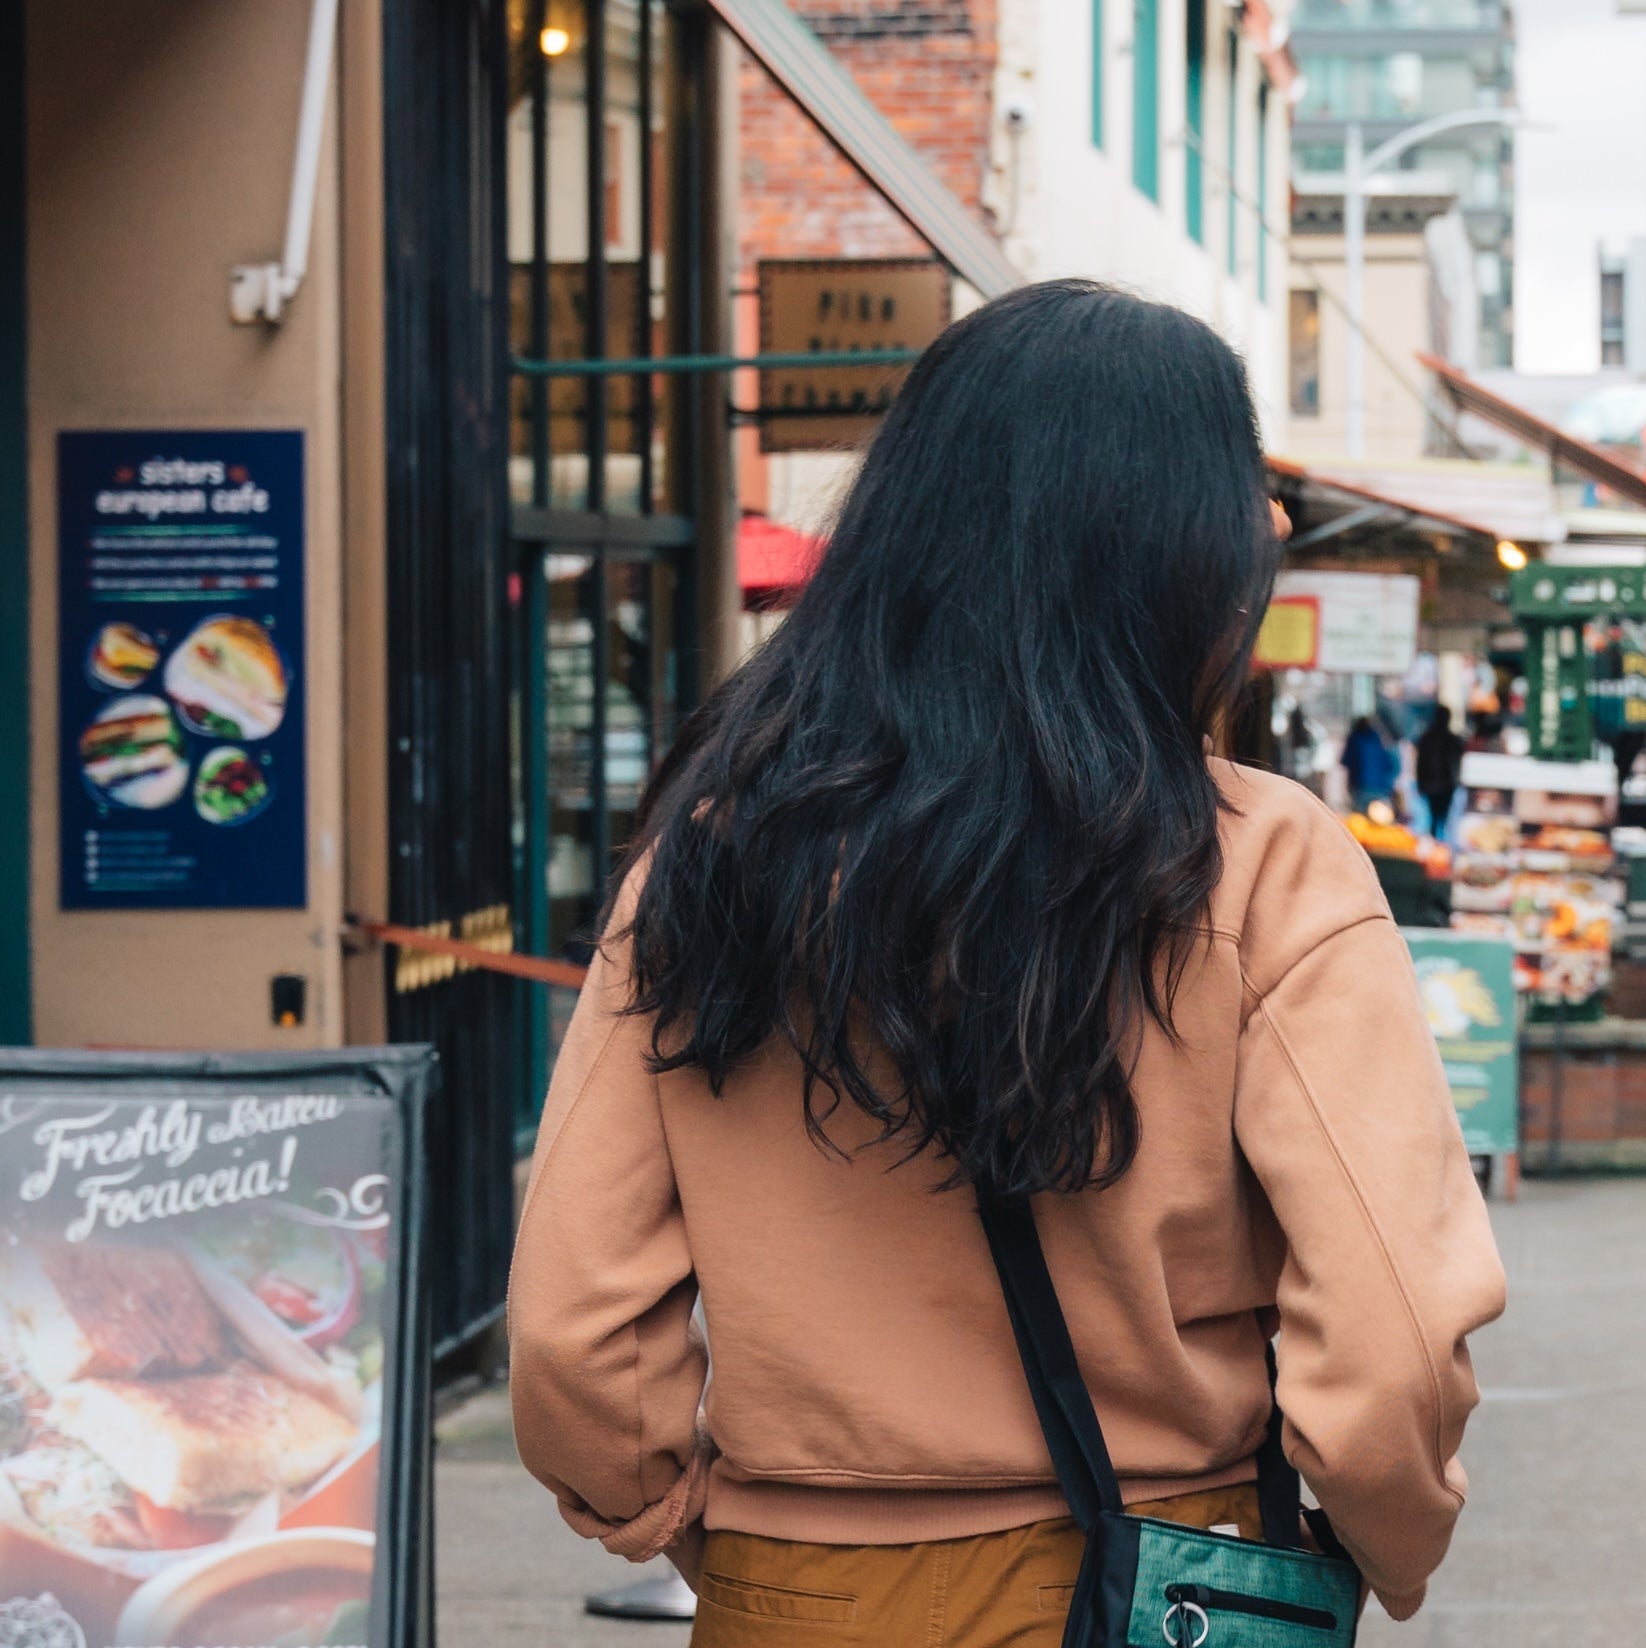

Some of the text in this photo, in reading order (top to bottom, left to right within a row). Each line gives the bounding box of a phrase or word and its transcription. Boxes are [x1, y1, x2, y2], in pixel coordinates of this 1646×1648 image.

[96, 481, 270, 521] european cafe
[140, 456, 226, 486] sisters
[20, 1098, 203, 1200] Freshly
[64, 1136, 298, 1243] Focaccia!
